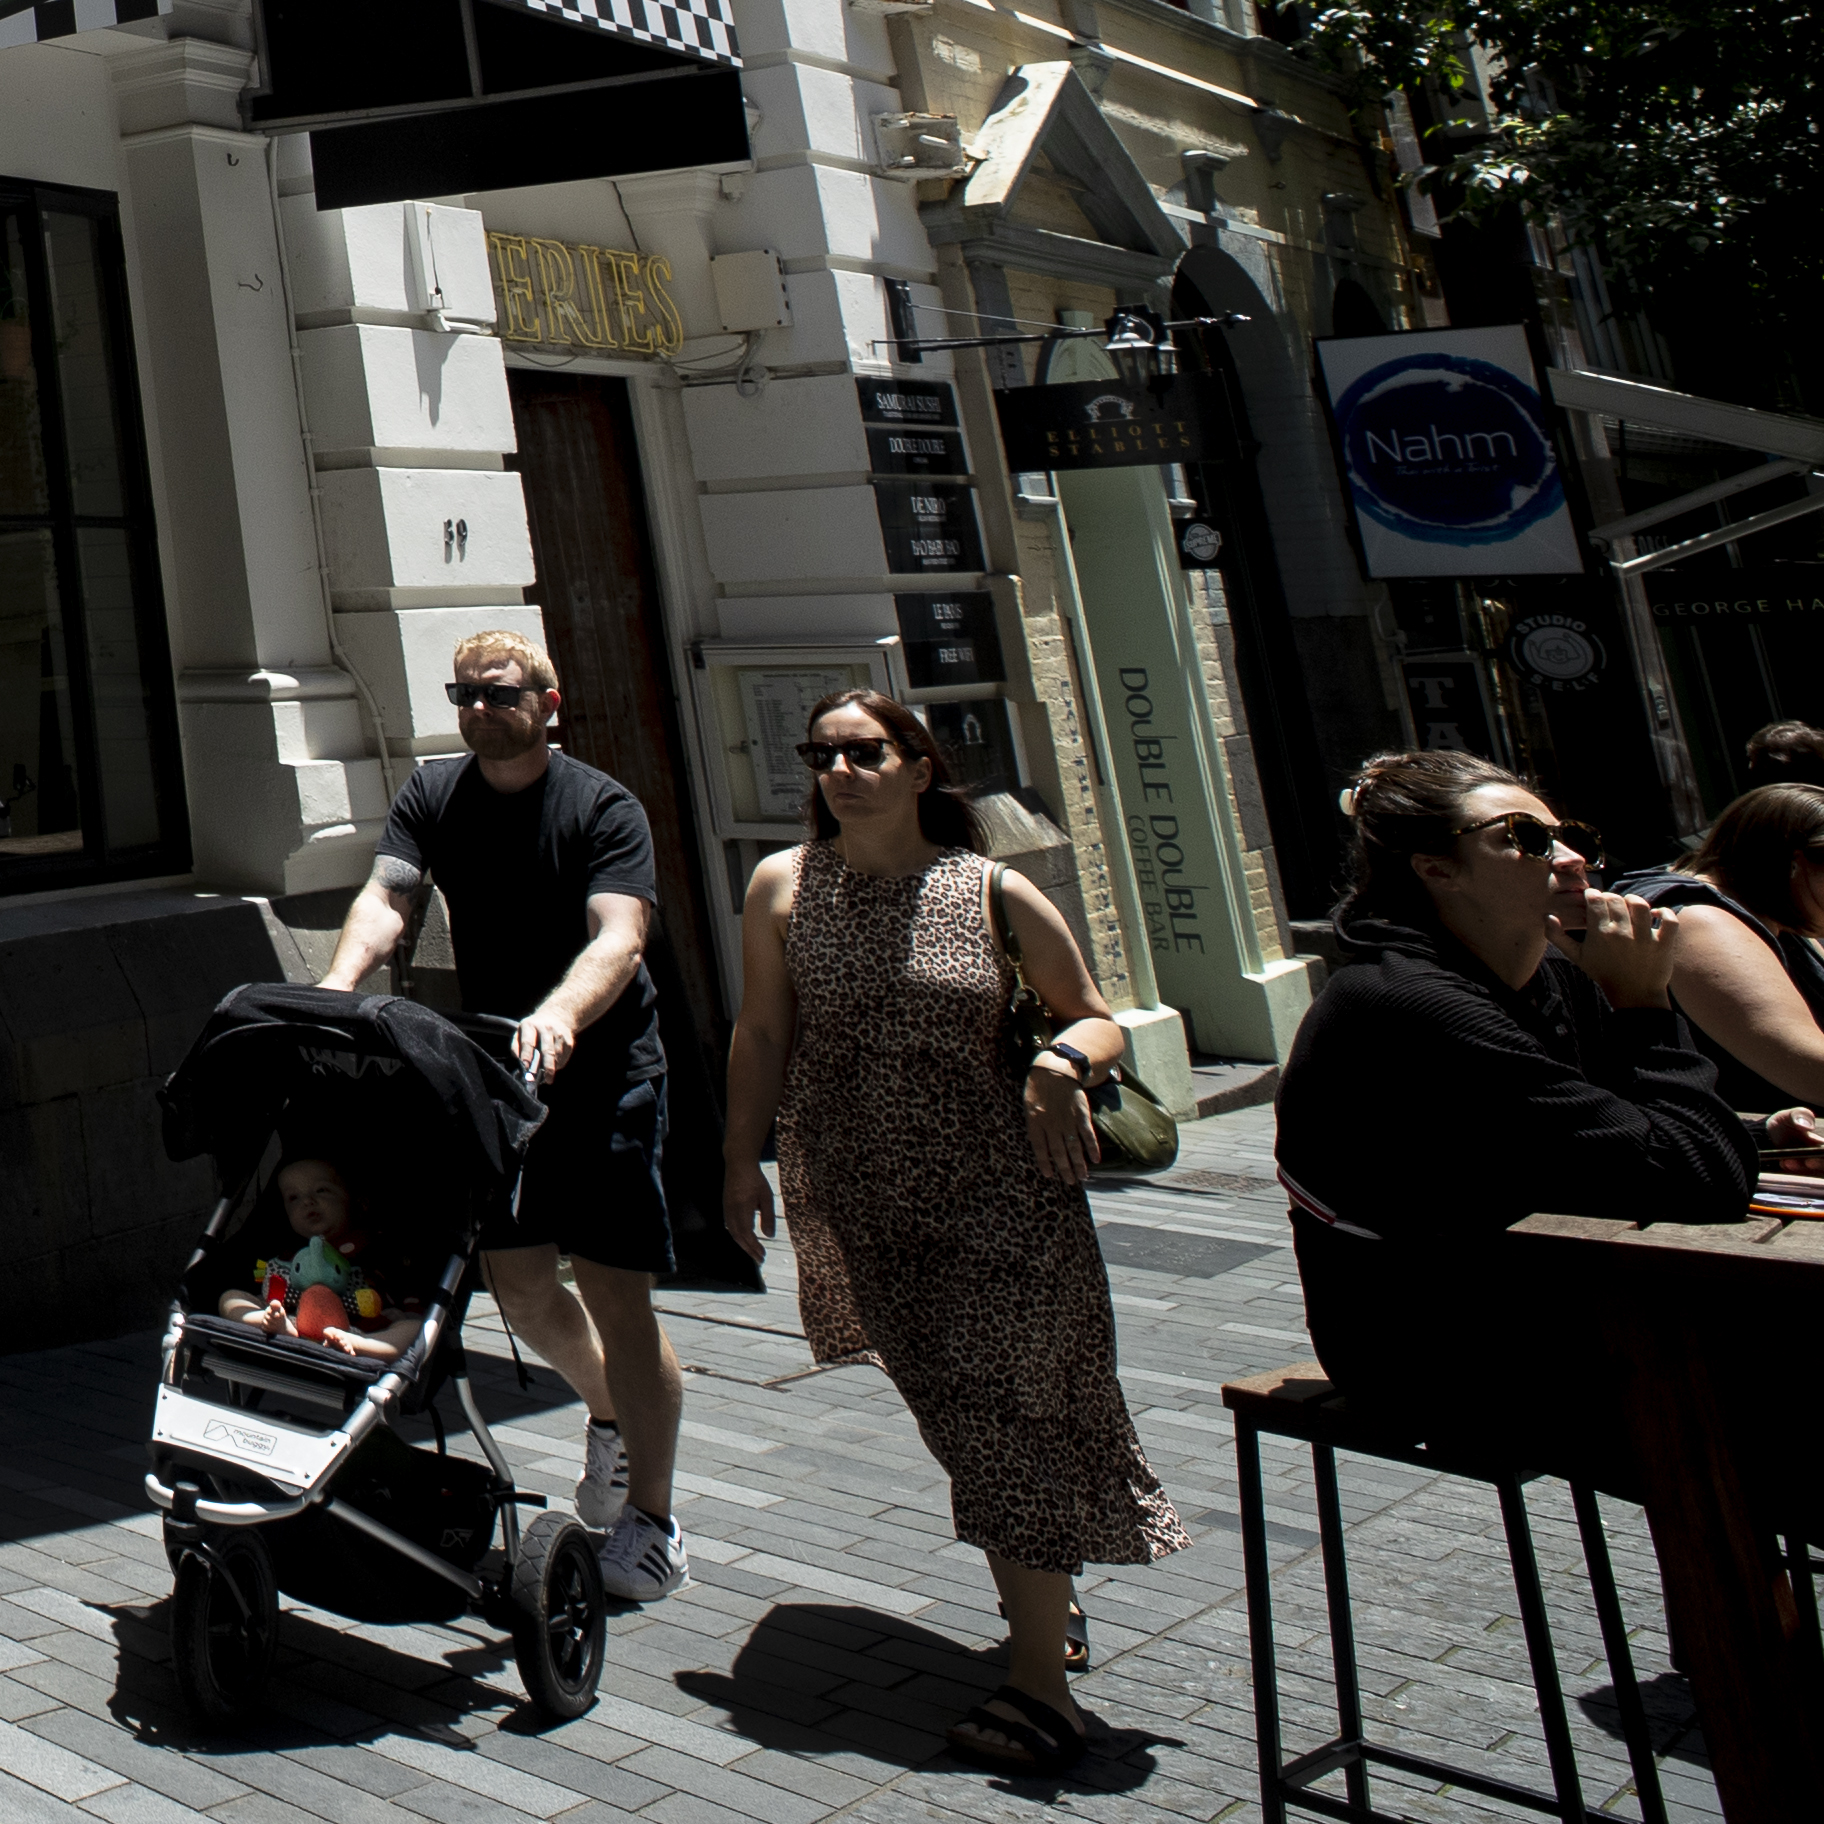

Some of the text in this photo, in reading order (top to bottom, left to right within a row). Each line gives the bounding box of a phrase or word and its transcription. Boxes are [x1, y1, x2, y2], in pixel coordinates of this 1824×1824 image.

[489, 232, 683, 356] ERIES
[1046, 422, 1186, 443] ELLIOTT
[1049, 436, 1191, 457] STABLES
[1364, 424, 1518, 463] Nahm
[443, 518, 468, 545] 39
[1652, 599, 1772, 616] GEORGE
[1515, 614, 1587, 635] STUDIO
[1119, 668, 1209, 955] DOUBLE DOUBLE
[1128, 815, 1170, 952] COFFEE BAR
[233, 1428, 272, 1444] mountain
[242, 1438, 268, 1451] buggy
